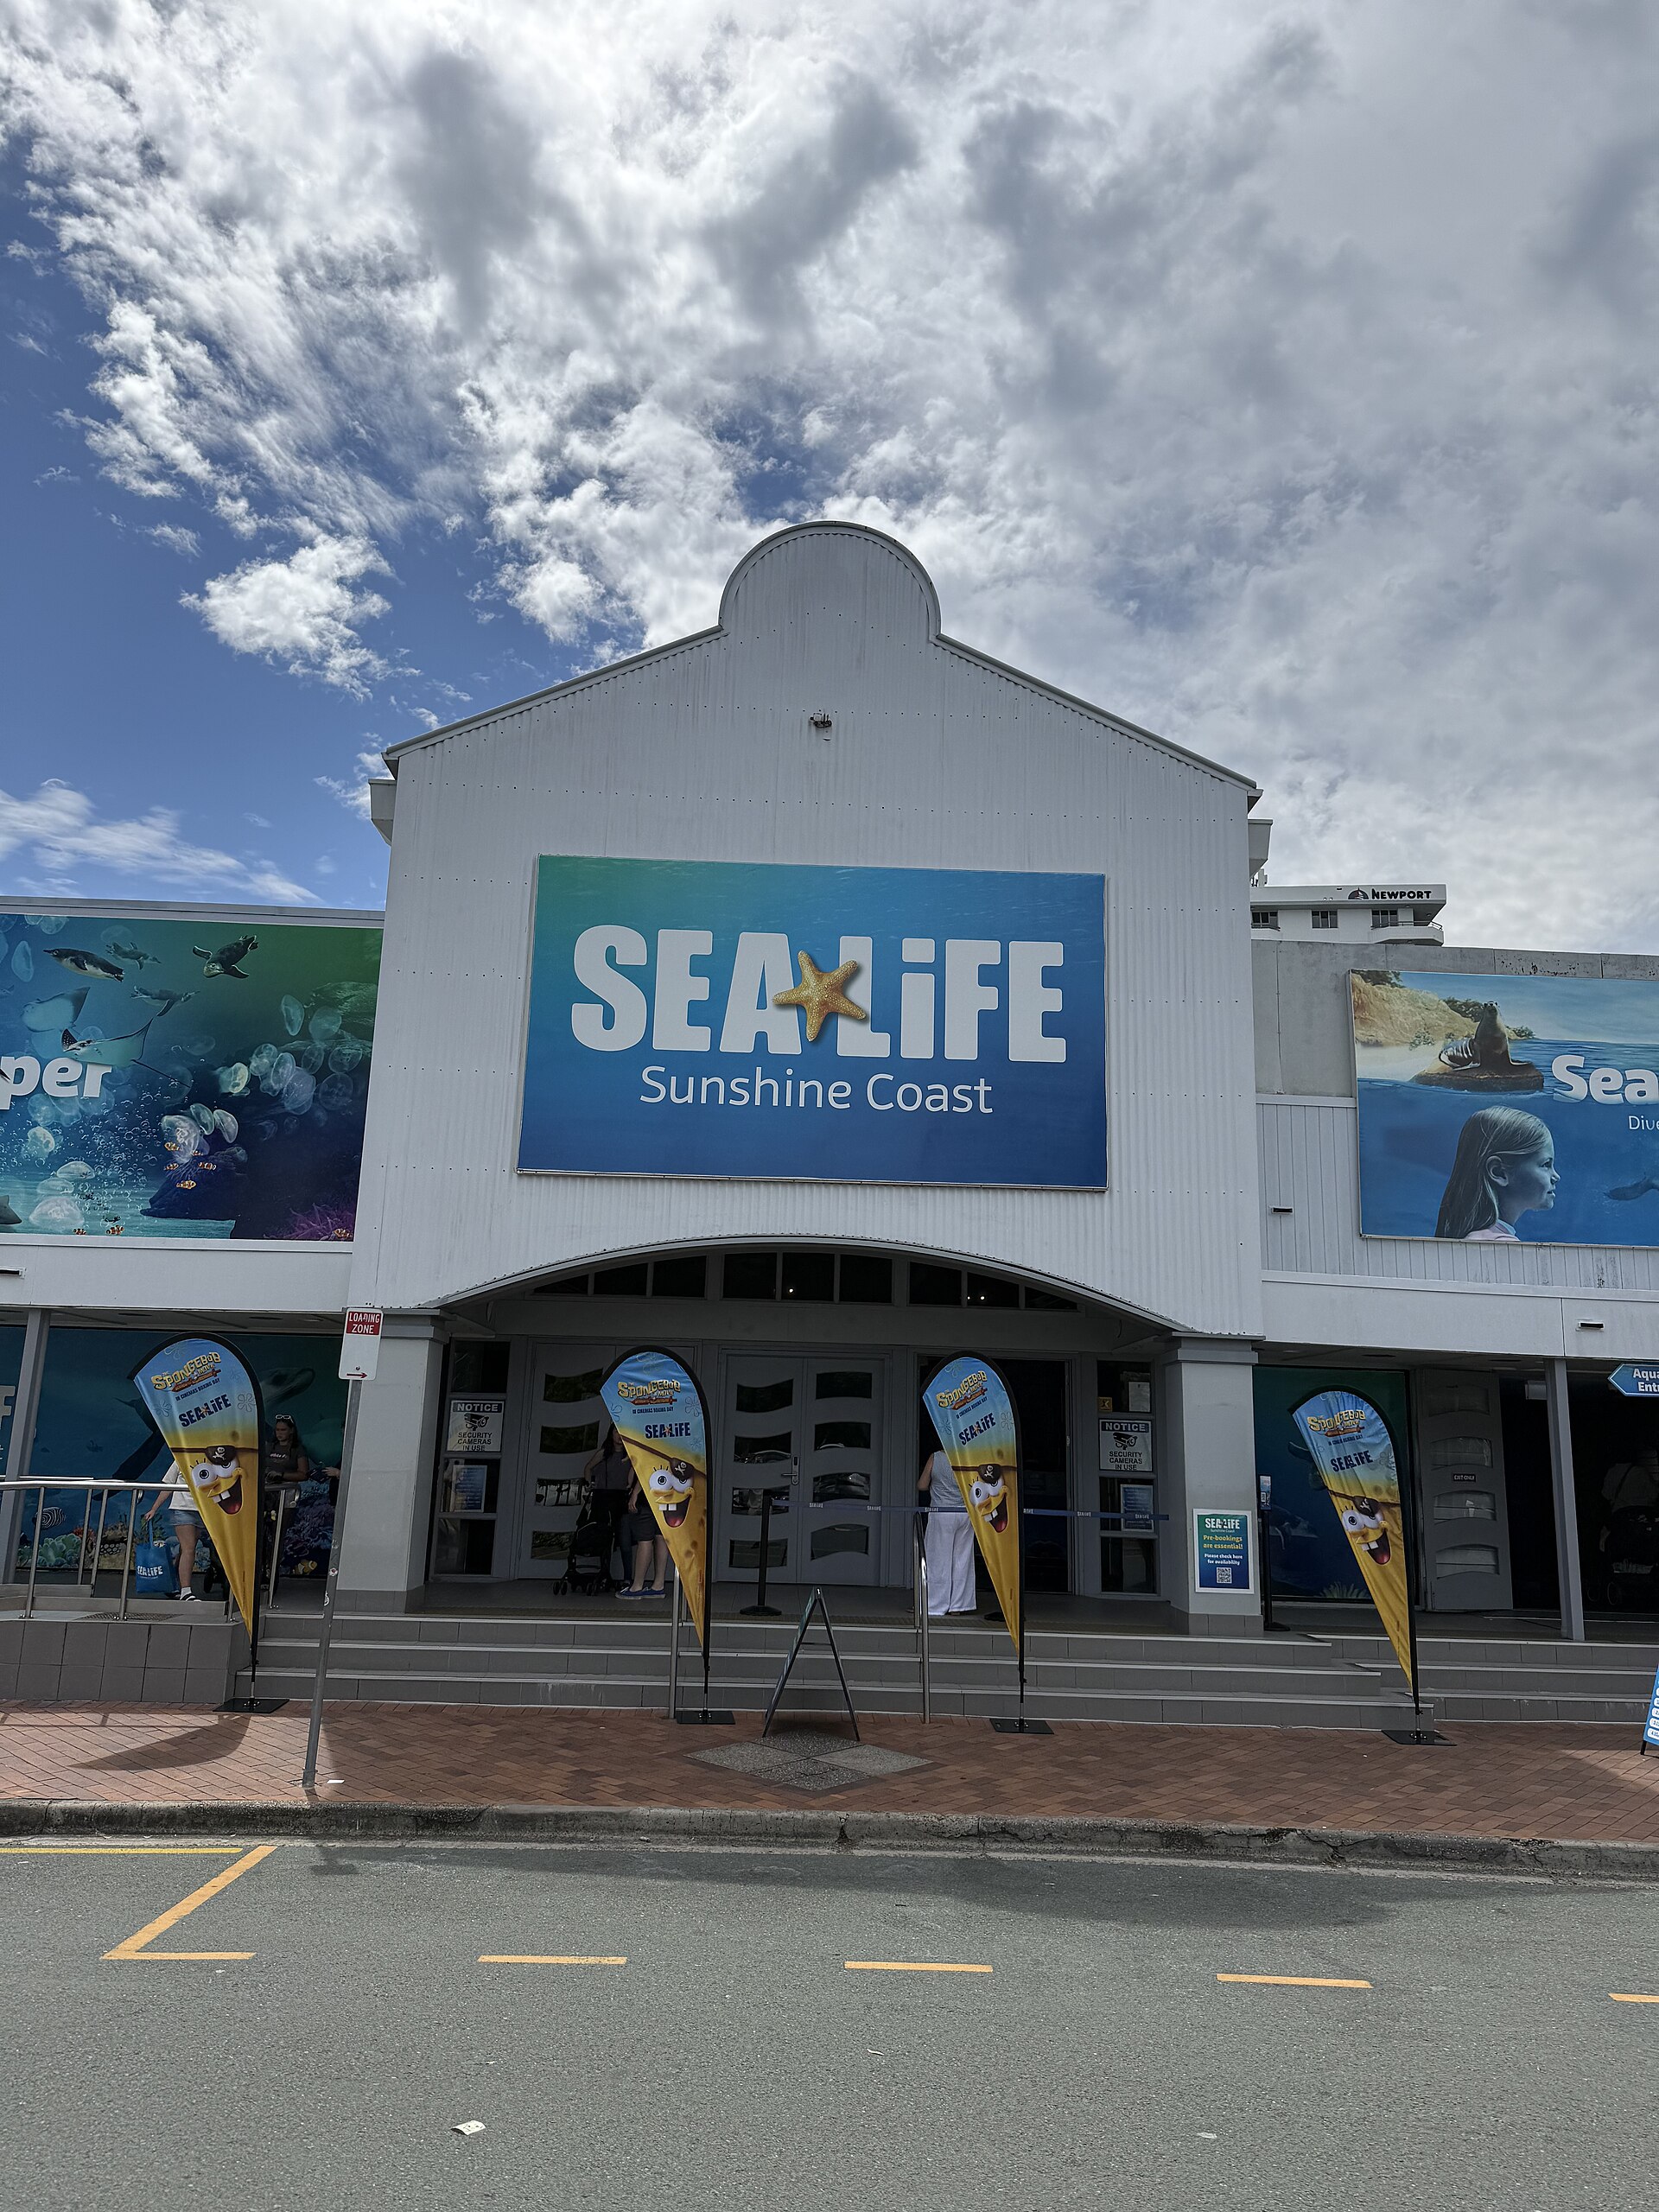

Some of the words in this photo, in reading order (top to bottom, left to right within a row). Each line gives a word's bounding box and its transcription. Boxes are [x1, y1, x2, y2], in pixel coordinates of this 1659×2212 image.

[1370, 888, 1432, 899] NEWPORT
[571, 925, 803, 1055] SEA
[639, 1065, 853, 1109] Sunshine
[866, 1073, 994, 1115] Coast
[348, 1312, 380, 1323] LOADING
[351, 1324, 375, 1334] ZONE
[150, 1351, 221, 1390] SPONGEBOB
[617, 1379, 681, 1398] SPONGEBOB
[936, 1370, 988, 1408] SPONGEBOB
[457, 1403, 499, 1412] NOTICE
[178, 1404, 207, 1427] SEA
[645, 1424, 665, 1439] SEA
[1105, 1422, 1146, 1432] NOTICE
[958, 1425, 978, 1446] SEA
[1205, 1517, 1222, 1529] SEA
[1203, 1535, 1243, 1543] Pre-bookings
